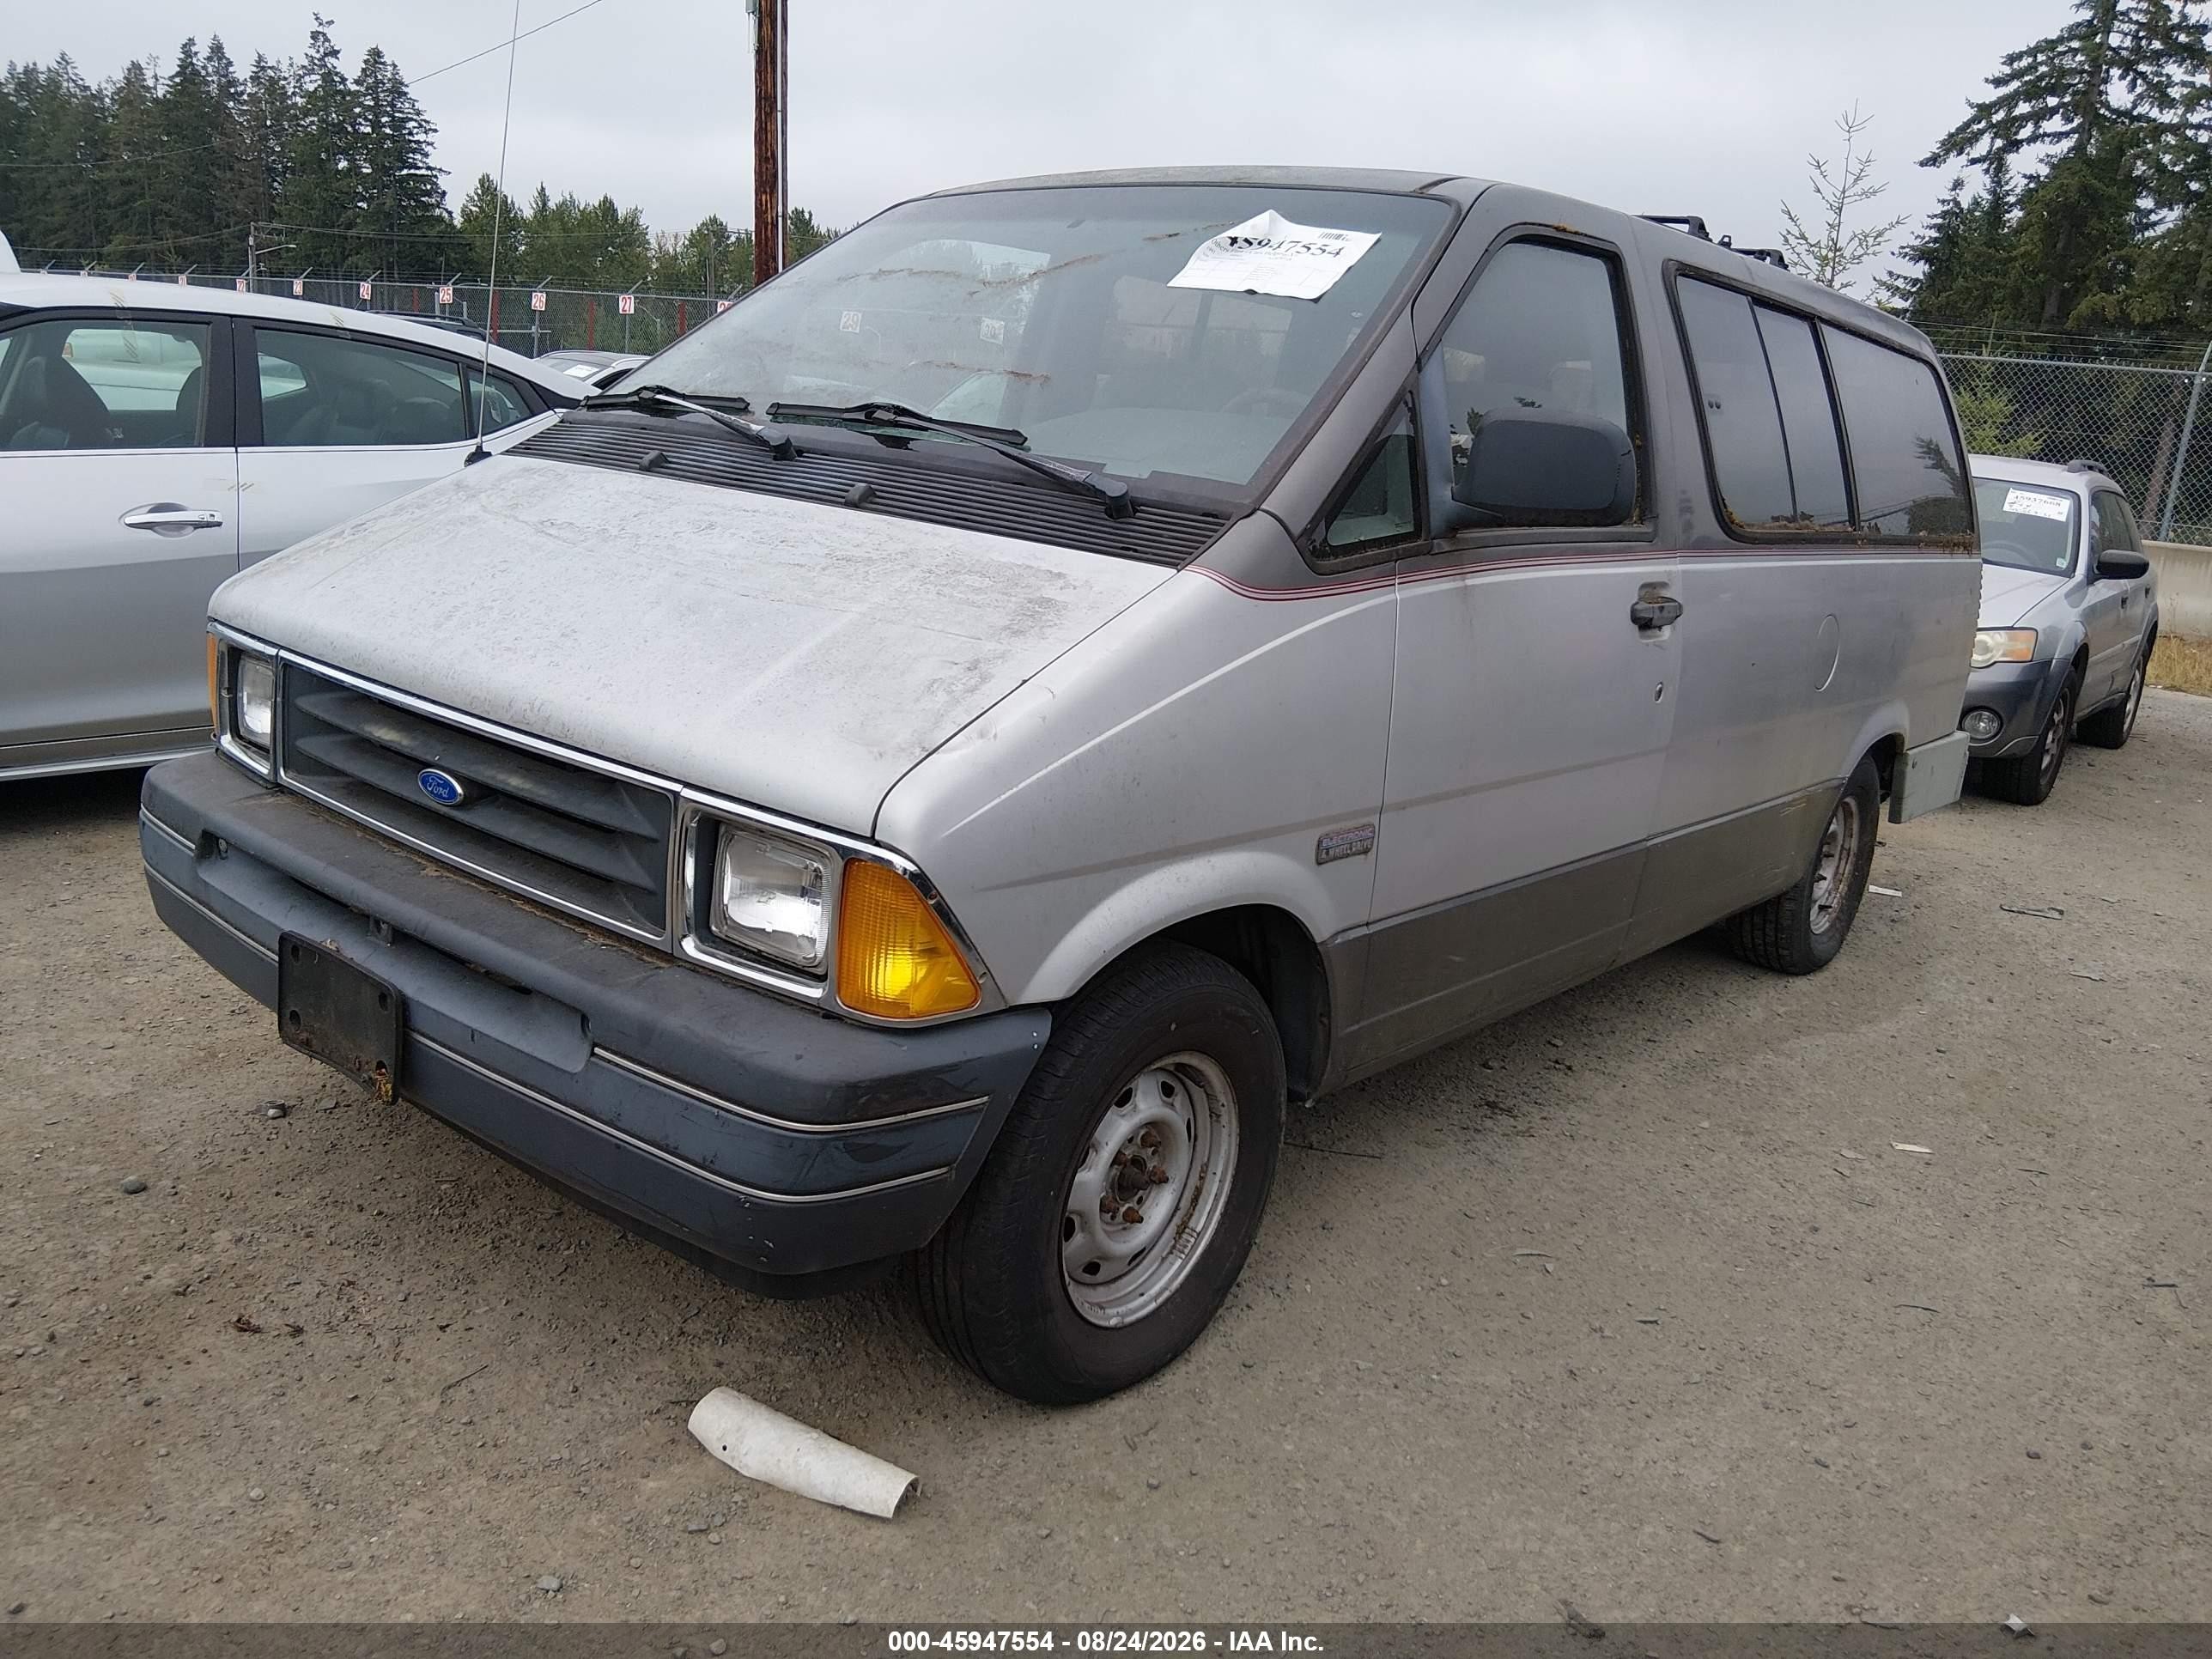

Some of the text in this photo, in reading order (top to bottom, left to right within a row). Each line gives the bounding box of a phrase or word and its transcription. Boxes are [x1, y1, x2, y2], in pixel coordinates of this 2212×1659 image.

[295, 282, 301, 295] 23
[362, 284, 370, 298] 24
[441, 289, 452, 303] 25
[533, 294, 545, 309] 26
[622, 296, 633, 313] 27
[843, 313, 859, 331] 29
[427, 776, 449, 798] Ford
